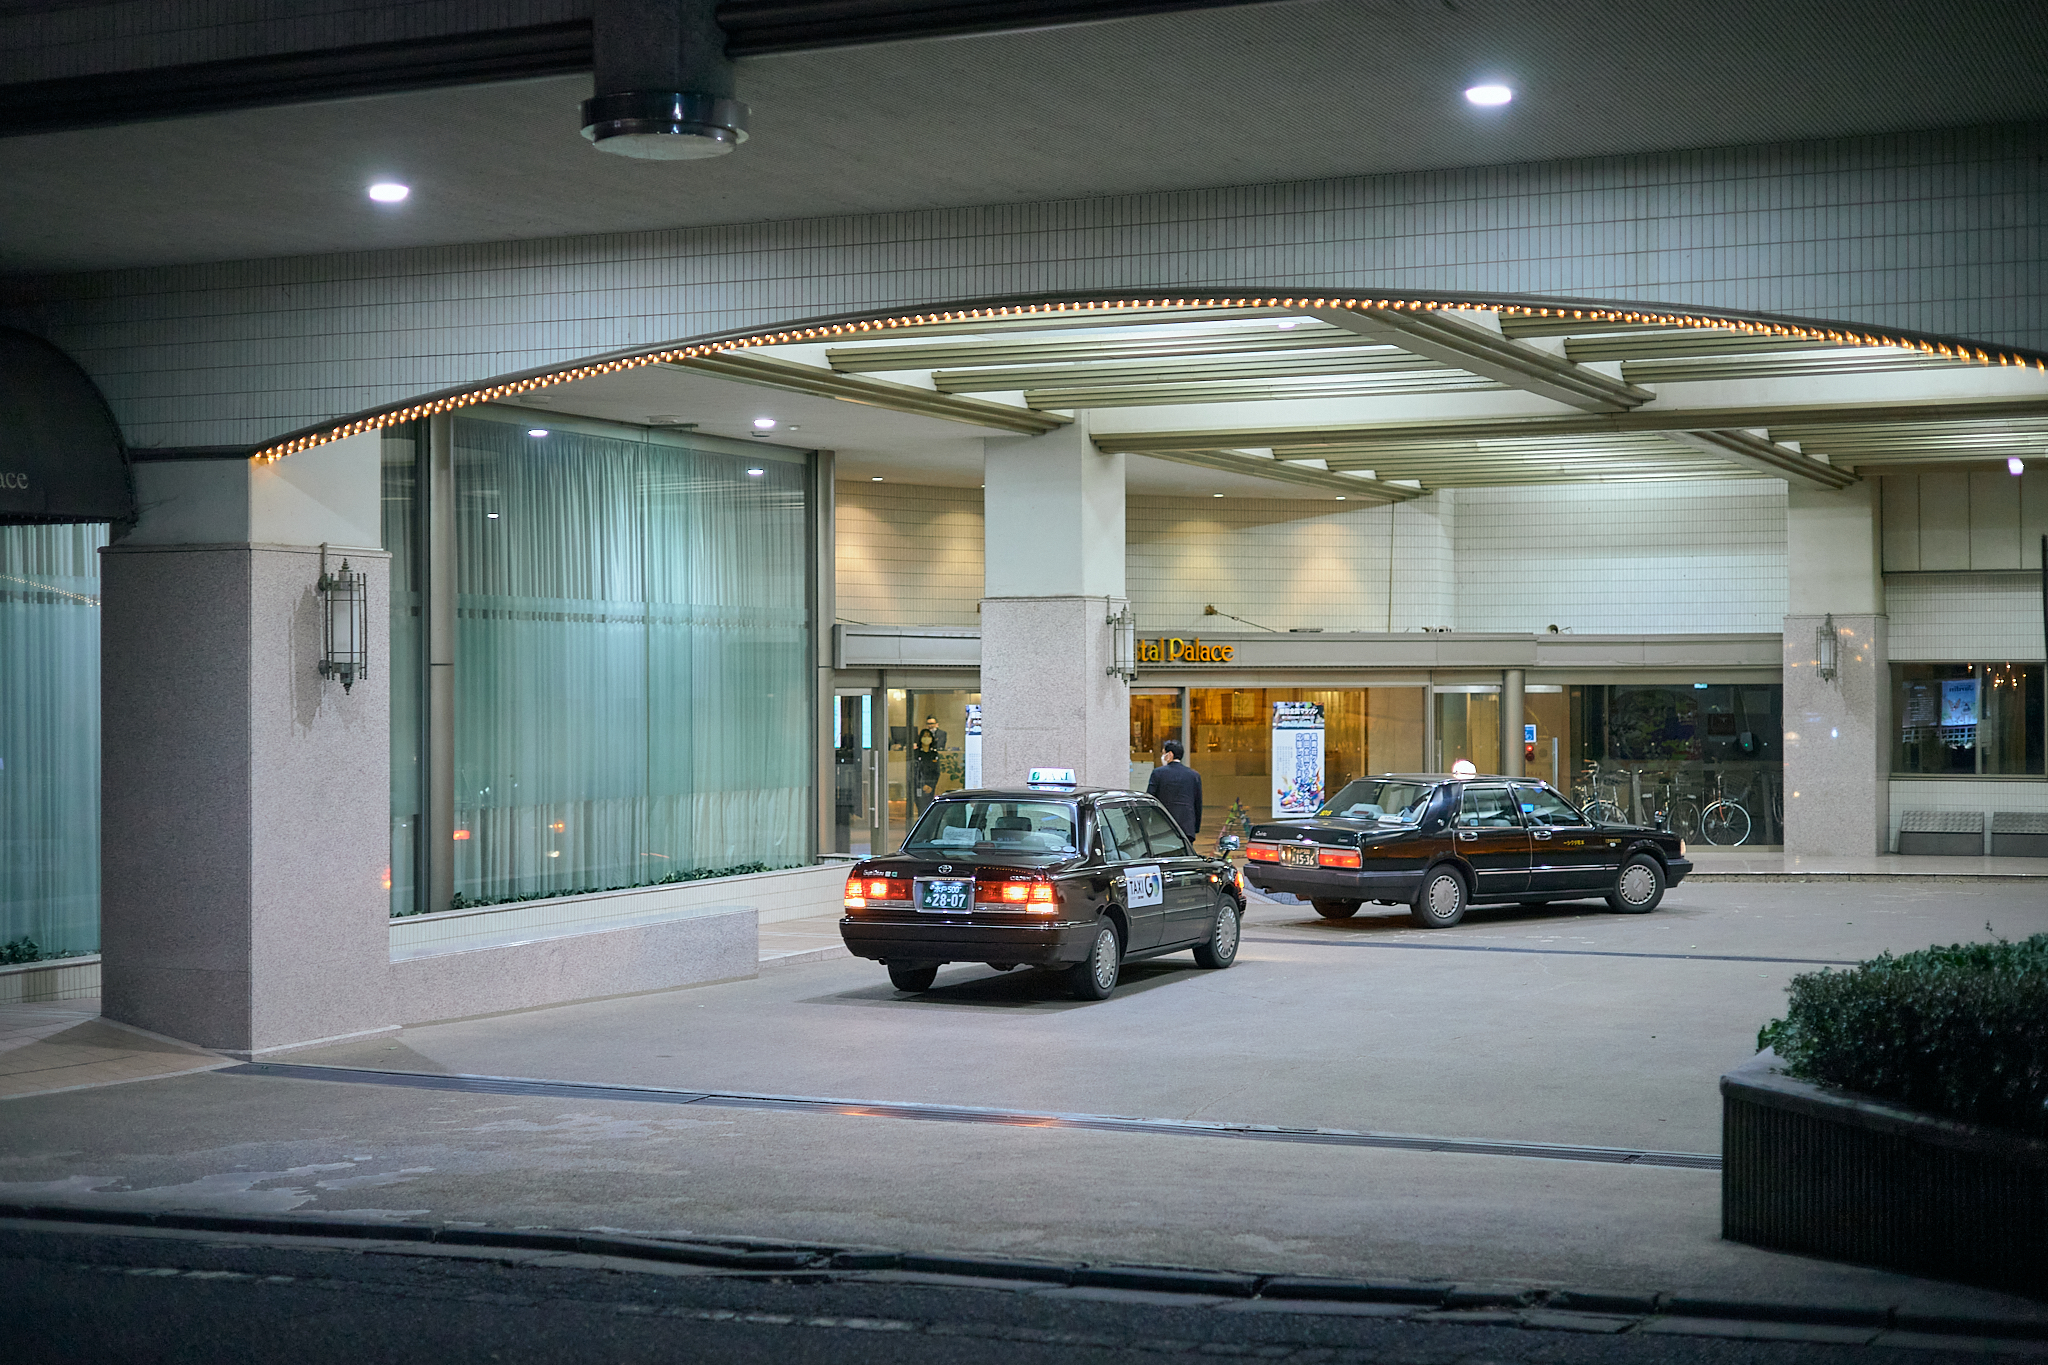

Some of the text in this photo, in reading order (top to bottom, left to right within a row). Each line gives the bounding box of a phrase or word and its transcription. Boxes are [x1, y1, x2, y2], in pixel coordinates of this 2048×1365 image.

[1169, 637, 1234, 662] Palace
[1296, 854, 1315, 866] 15-36
[932, 893, 966, 908] 28-07
